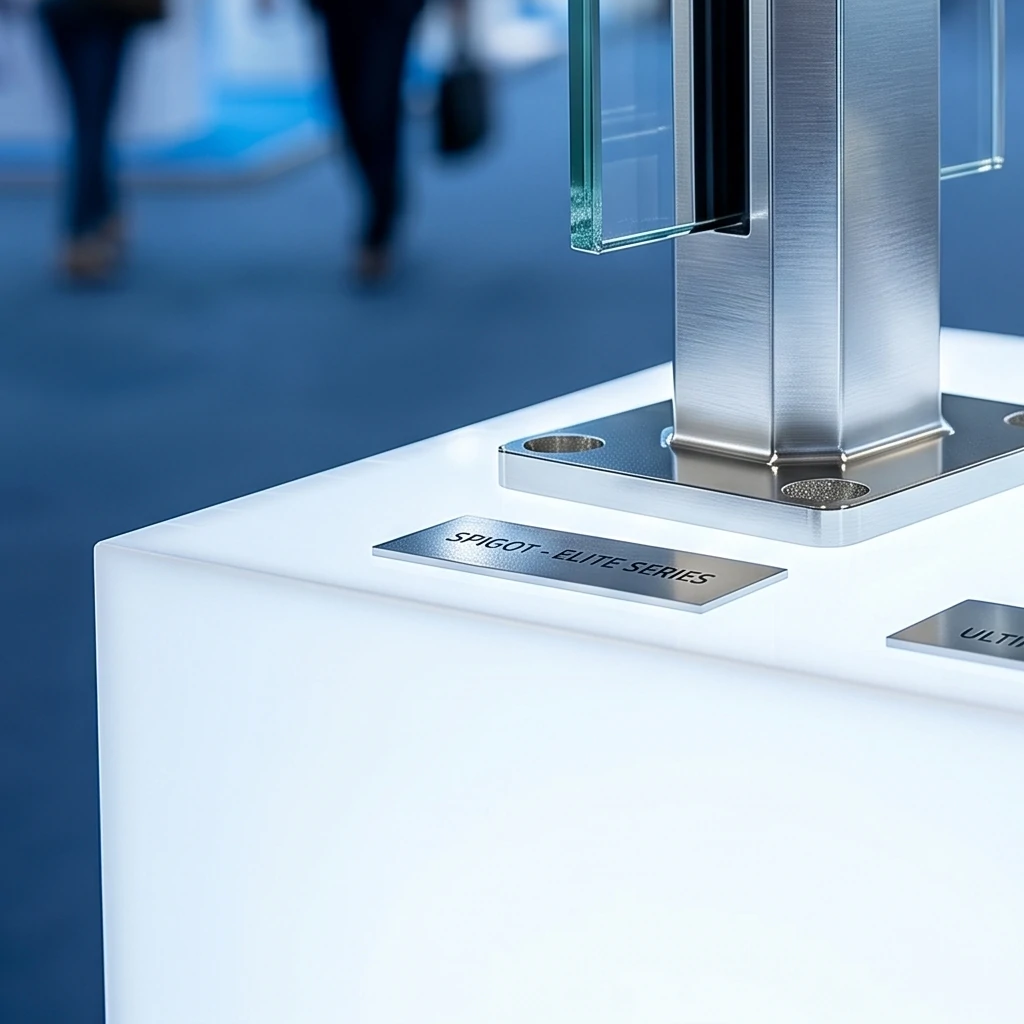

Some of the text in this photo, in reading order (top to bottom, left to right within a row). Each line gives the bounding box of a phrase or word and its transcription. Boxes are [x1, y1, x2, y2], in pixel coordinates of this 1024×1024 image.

[445, 532, 542, 554] SPIGOT
[551, 549, 627, 569] ELITE
[623, 561, 716, 585] SERIES
